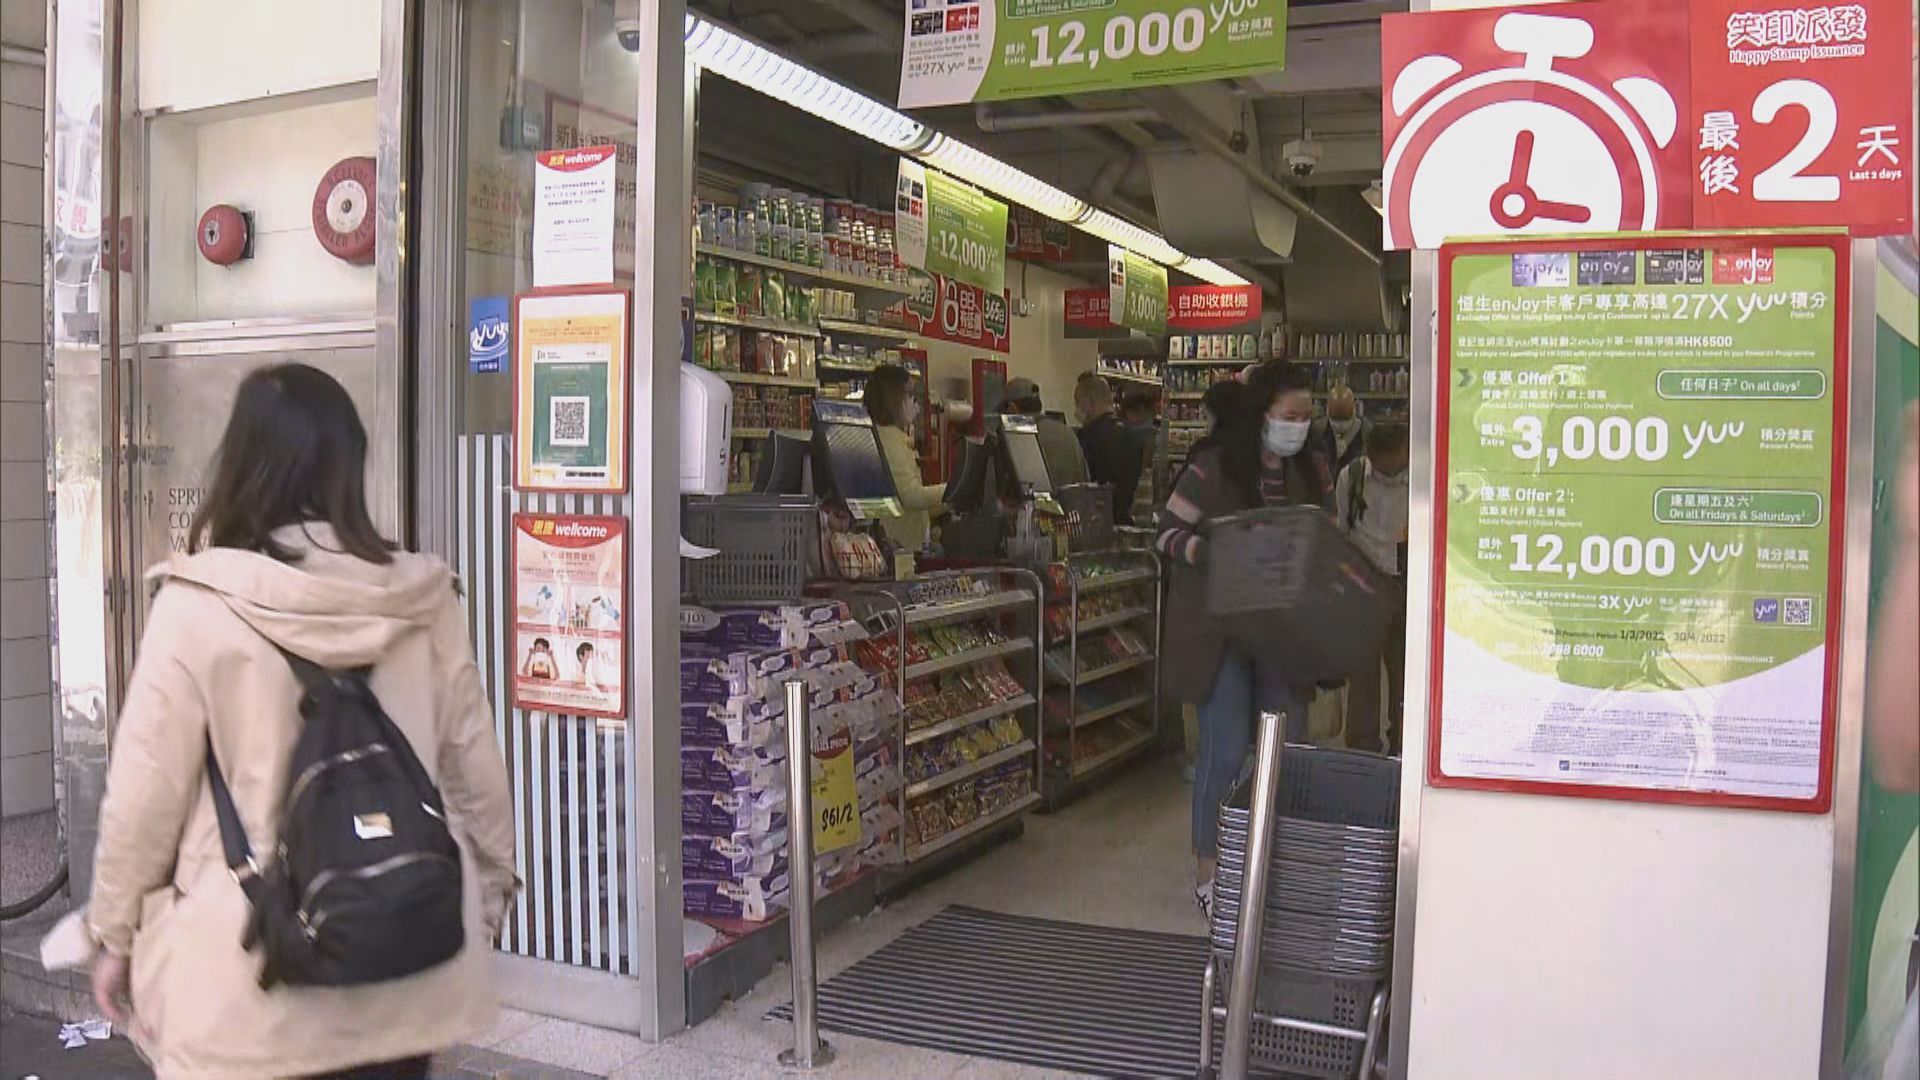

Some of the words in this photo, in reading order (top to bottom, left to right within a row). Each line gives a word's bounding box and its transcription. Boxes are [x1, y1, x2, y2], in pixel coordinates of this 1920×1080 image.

[1727, 5, 1867, 48] 笑印派發
[1030, 7, 1205, 69] 12,000
[1729, 50, 1769, 65] Happy
[1771, 48, 1810, 62] Stamp
[1811, 45, 1865, 58] Issuance
[1699, 111, 1740, 195] 最後
[1751, 79, 1840, 201] 2
[1857, 124, 1899, 168] 天
[1849, 170, 1869, 181] Last
[1879, 168, 1902, 181] days
[940, 230, 986, 272] 12,000
[1130, 291, 1157, 322] 3,000
[1179, 294, 1248, 307] 自助收銀機
[1671, 294, 1729, 319] 27X
[1736, 292, 1787, 323] yuu
[1517, 372, 1553, 385] Offer
[1740, 380, 1755, 391] On
[1757, 379, 1771, 391] all
[1480, 438, 1505, 447] Extra
[1511, 415, 1669, 467] 3,000
[1682, 420, 1745, 460] yuu
[1515, 488, 1552, 502] Offer
[1669, 508, 1683, 519] On
[1685, 509, 1698, 519] all
[1700, 510, 1737, 521] Fridays
[1739, 511, 1747, 519] &
[555, 523, 607, 537] wellcome
[1478, 551, 1502, 560] Extra
[1509, 534, 1675, 579] 12,000
[1688, 542, 1744, 575] yuu
[1599, 595, 1620, 610] 3X
[1624, 595, 1652, 614] yuu
[1755, 603, 1777, 620] yuu
[1573, 645, 1604, 657] 6000
